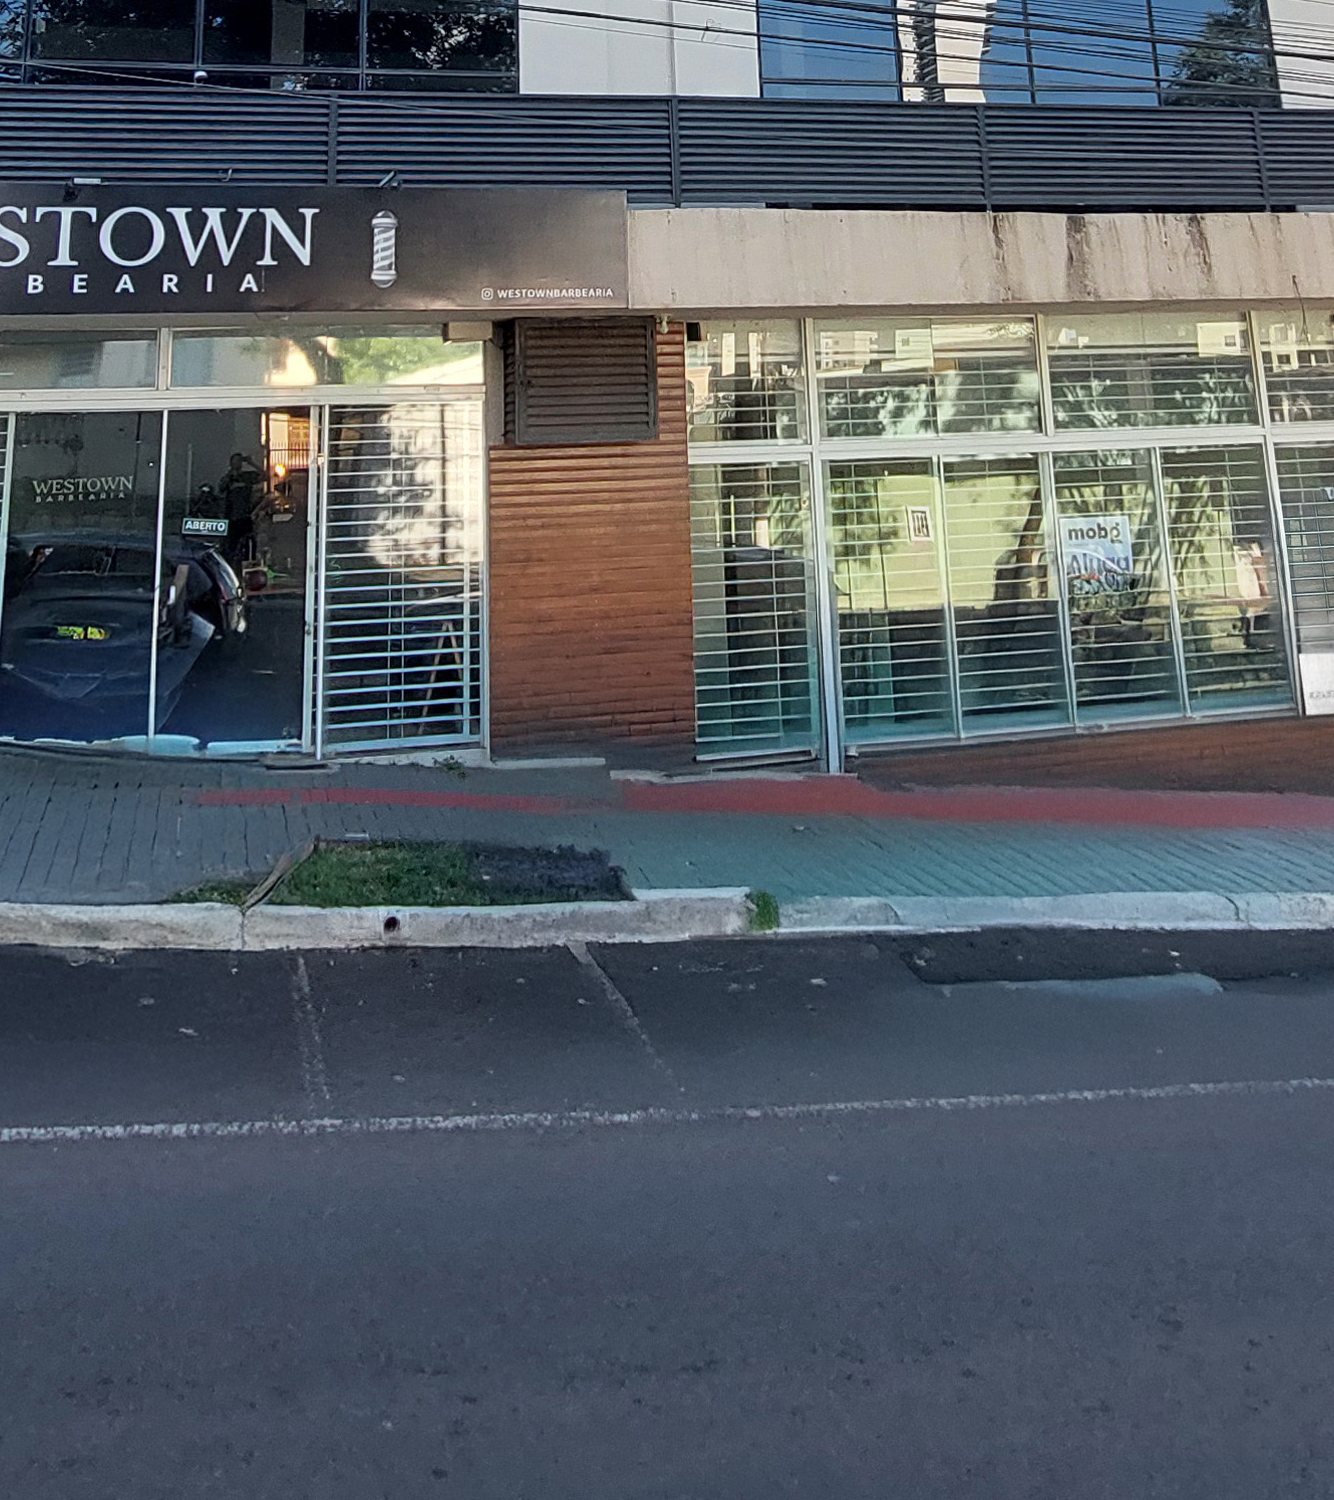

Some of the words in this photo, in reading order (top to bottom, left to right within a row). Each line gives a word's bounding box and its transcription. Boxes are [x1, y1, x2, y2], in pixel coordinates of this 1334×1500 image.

[496, 287, 615, 299] WESTOWNBARBEARIA
[32, 475, 134, 495] WESTOWN
[35, 492, 126, 503] BARBEARIA
[185, 520, 226, 532] ABERTO
